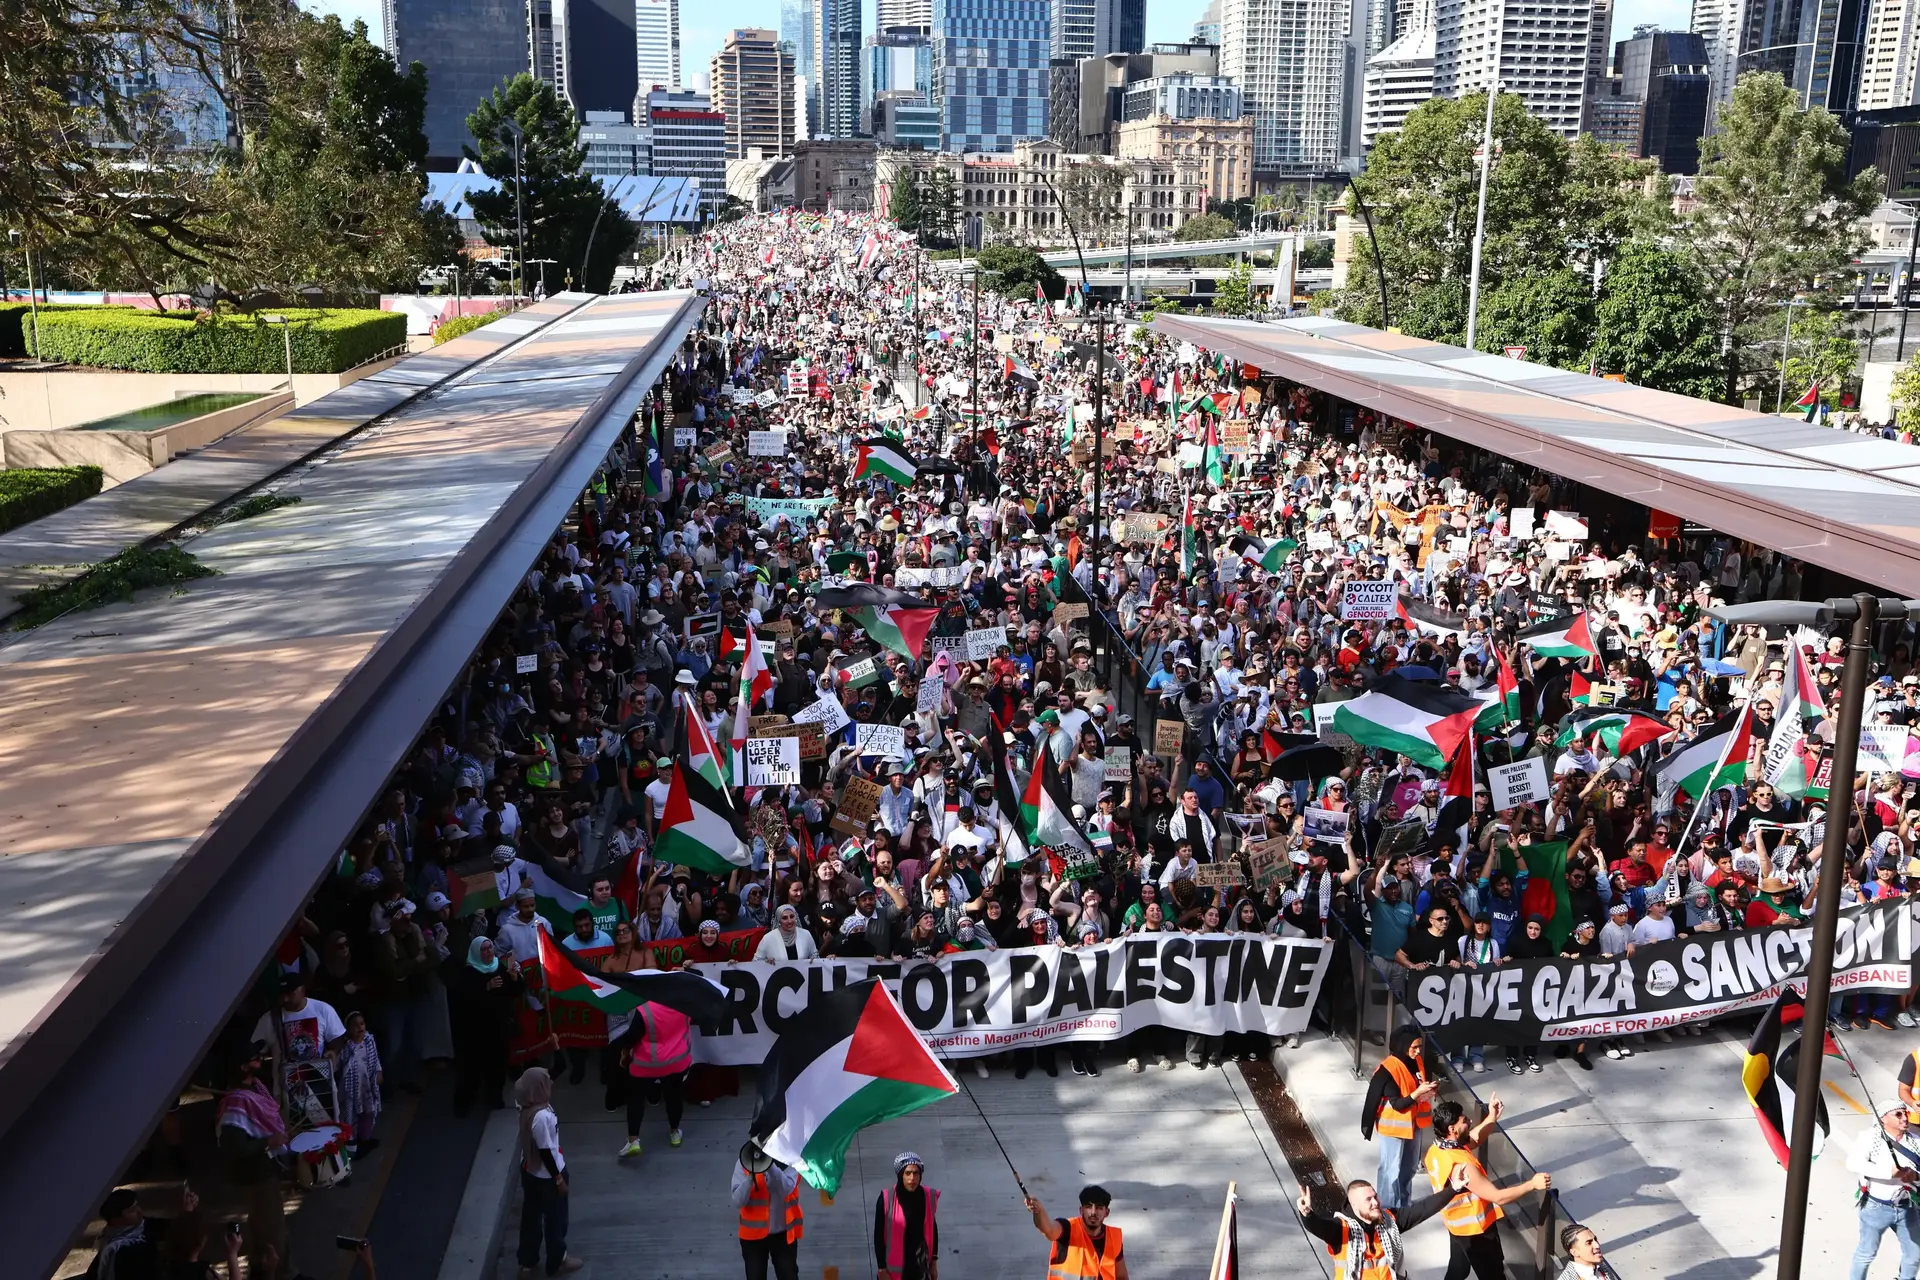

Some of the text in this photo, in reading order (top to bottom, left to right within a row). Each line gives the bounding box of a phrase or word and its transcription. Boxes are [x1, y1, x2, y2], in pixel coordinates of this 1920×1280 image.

[799, 501, 812, 511] THE
[1347, 583, 1394, 592] BOYCOTT
[1357, 594, 1392, 603] CALTEX
[1536, 594, 1554, 605] FREE
[1347, 610, 1388, 619] GENOCIDE
[934, 638, 961, 648] FREE
[850, 662, 869, 675] FREE
[803, 702, 822, 718] STOP
[758, 716, 778, 725] FREE
[772, 725, 796, 733] CANNOT
[858, 726, 904, 736] CHILDREN
[859, 734, 898, 744] DESERVE
[749, 747, 780, 756] LOSER
[864, 743, 896, 754] PEACE
[749, 755, 780, 765] WE'RE
[1105, 755, 1130, 765] SILENCE
[1104, 768, 1131, 776] VIOLENCE
[1499, 762, 1532, 776] FREE PALESTINE
[1508, 772, 1527, 783] EXIST!
[1508, 782, 1531, 794] RESIST!
[1813, 778, 1831, 788] NO
[1509, 792, 1534, 805] RETURN!
[844, 796, 869, 812] FREE
[1070, 852, 1087, 861] NOT
[1252, 850, 1276, 868] FREE
[600, 923, 613, 931] ALL
[653, 944, 683, 966] NO
[1414, 968, 1523, 1027] SAVE
[1531, 959, 1637, 1022] GAZA
[1682, 908, 1886, 1000] SANCTON
[1009, 938, 1323, 1024] PALESTINE
[984, 1017, 1117, 1046] Magan-djin/Brisbane
[1547, 1022, 1611, 1037] JUSTICE
[1616, 1018, 1647, 1032] FOR
